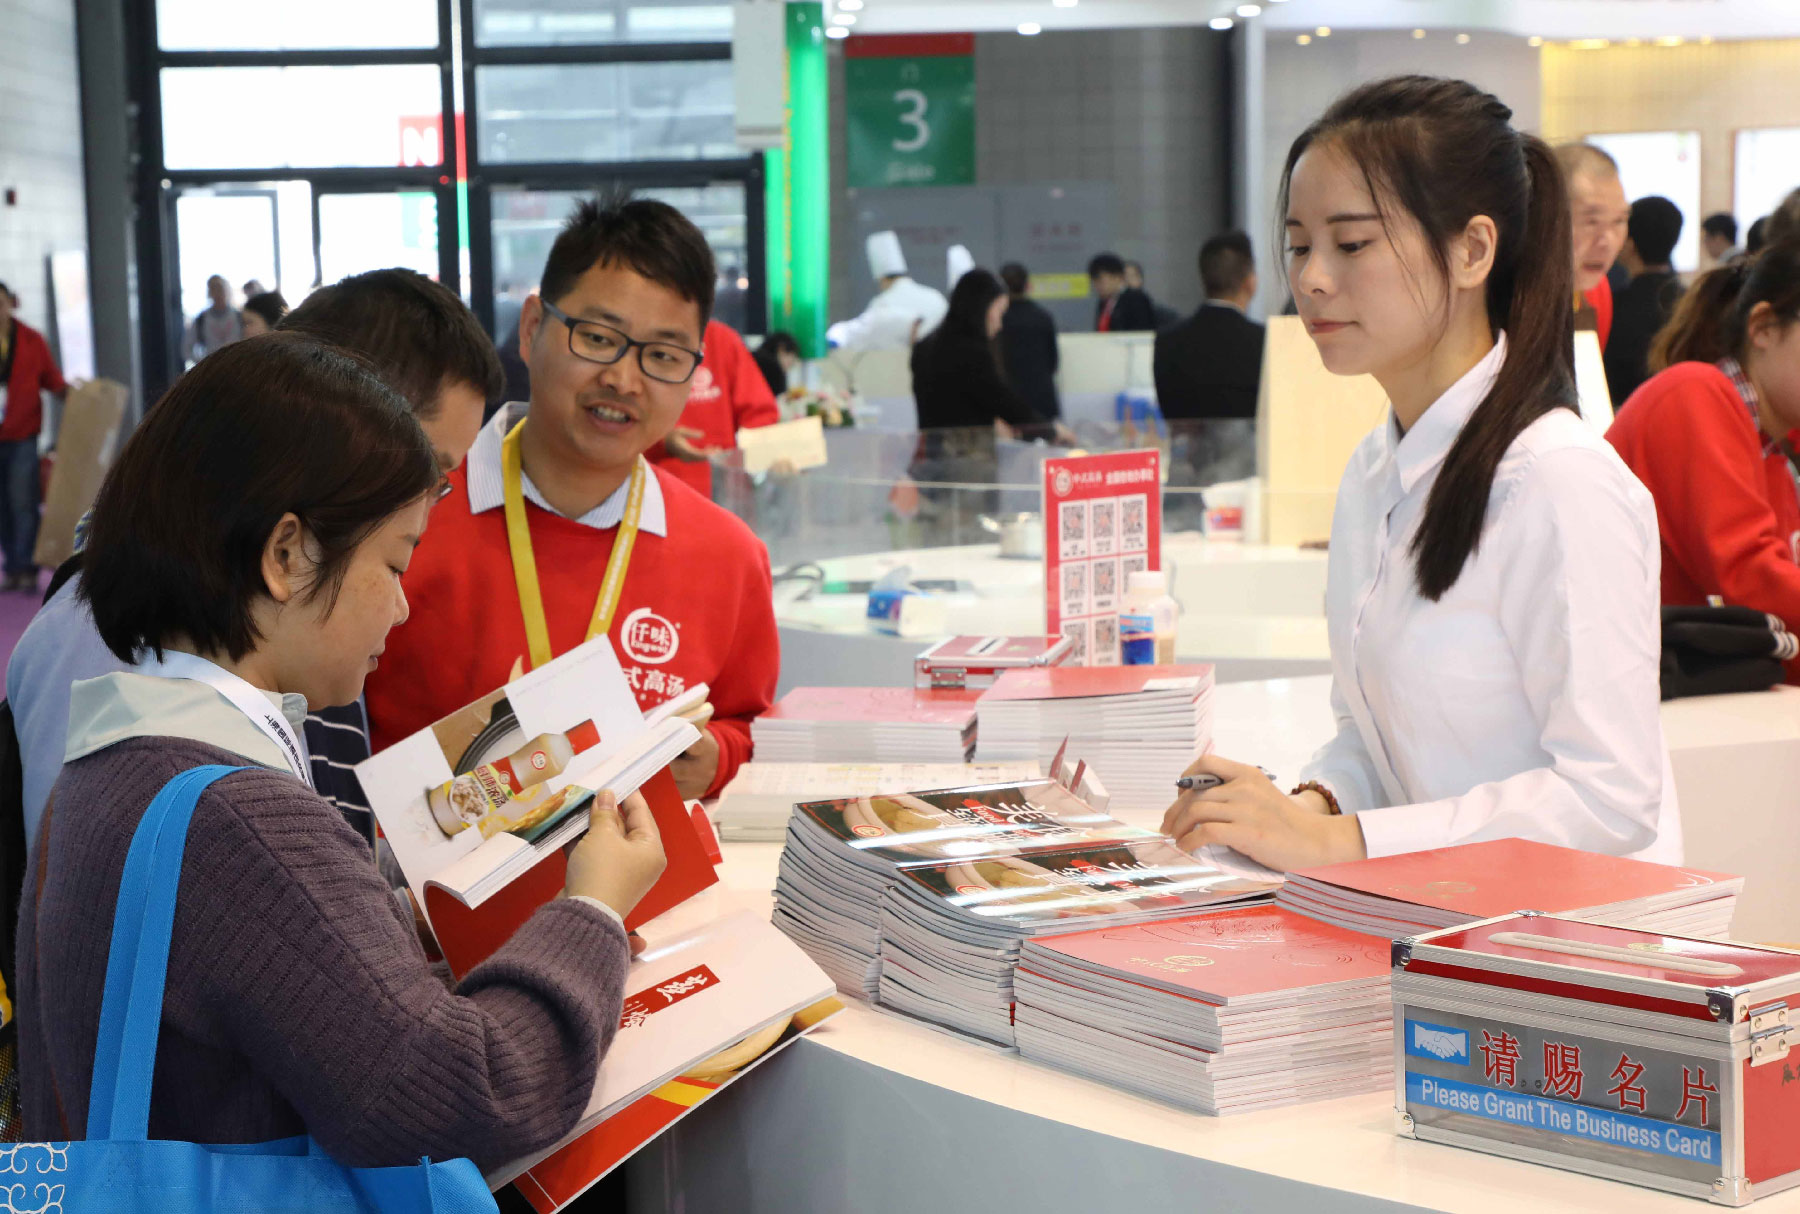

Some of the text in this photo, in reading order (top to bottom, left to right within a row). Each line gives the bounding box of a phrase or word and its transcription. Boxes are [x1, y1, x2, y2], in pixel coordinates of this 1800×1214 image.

[891, 88, 930, 152] 3
[1477, 1029, 1719, 1126] 请赐名片
[1422, 1079, 1712, 1159] Please Grant The Business Card
